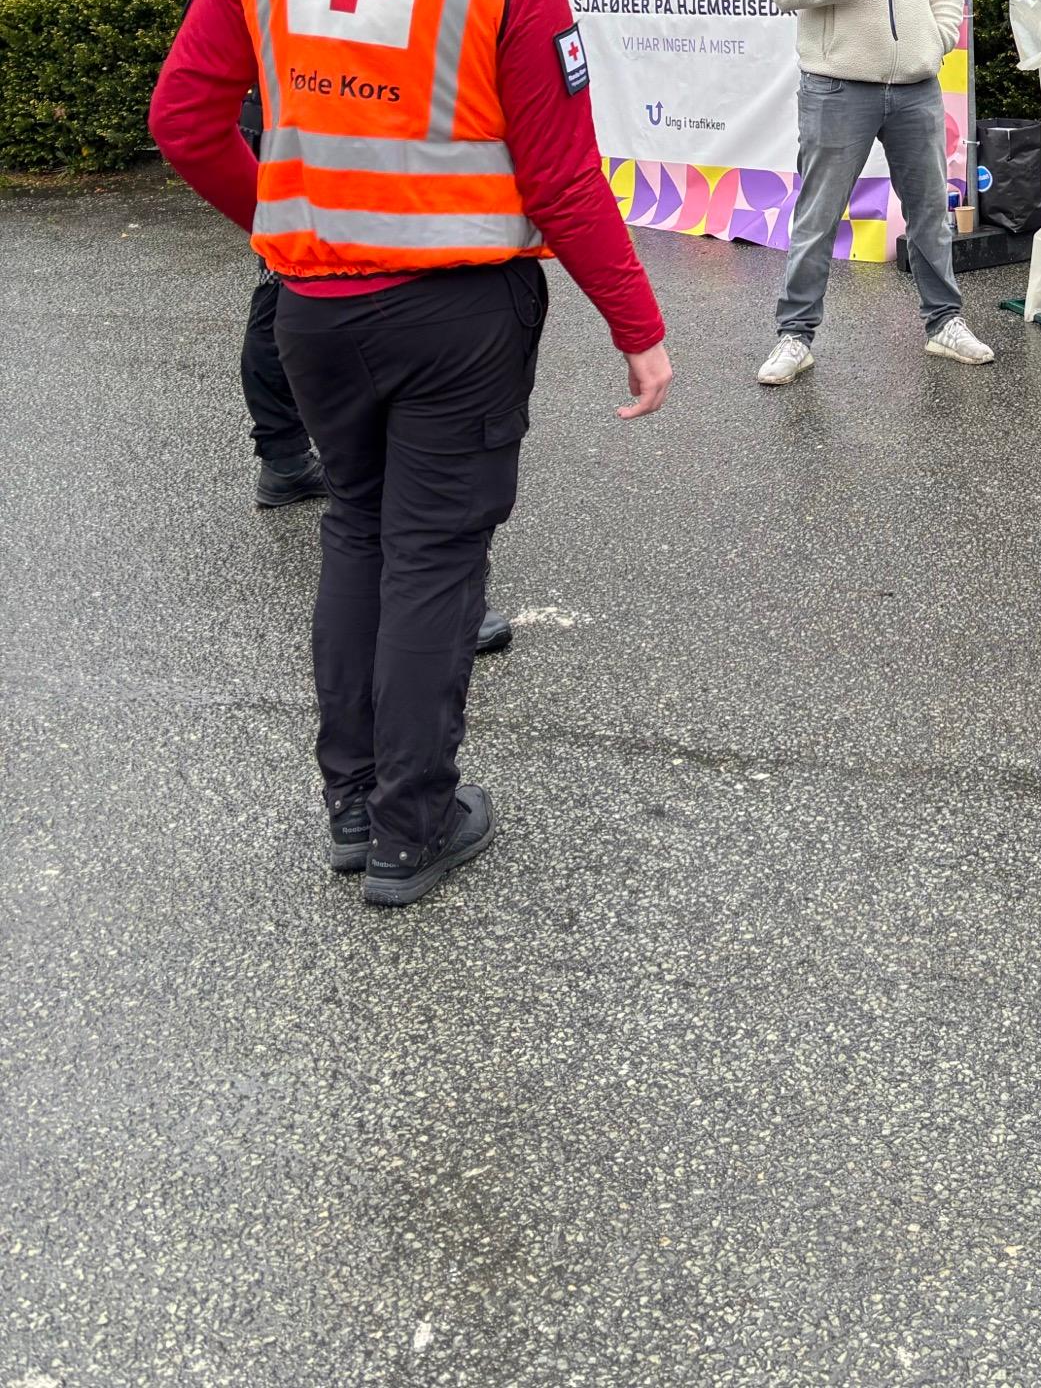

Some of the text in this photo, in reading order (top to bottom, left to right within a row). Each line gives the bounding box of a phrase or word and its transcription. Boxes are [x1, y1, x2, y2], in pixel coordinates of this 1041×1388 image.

[622, 35, 745, 55] VI HAR INGEN Å MISTE
[340, 74, 401, 103] Kors
[665, 115, 726, 131] Ung i trafikken
